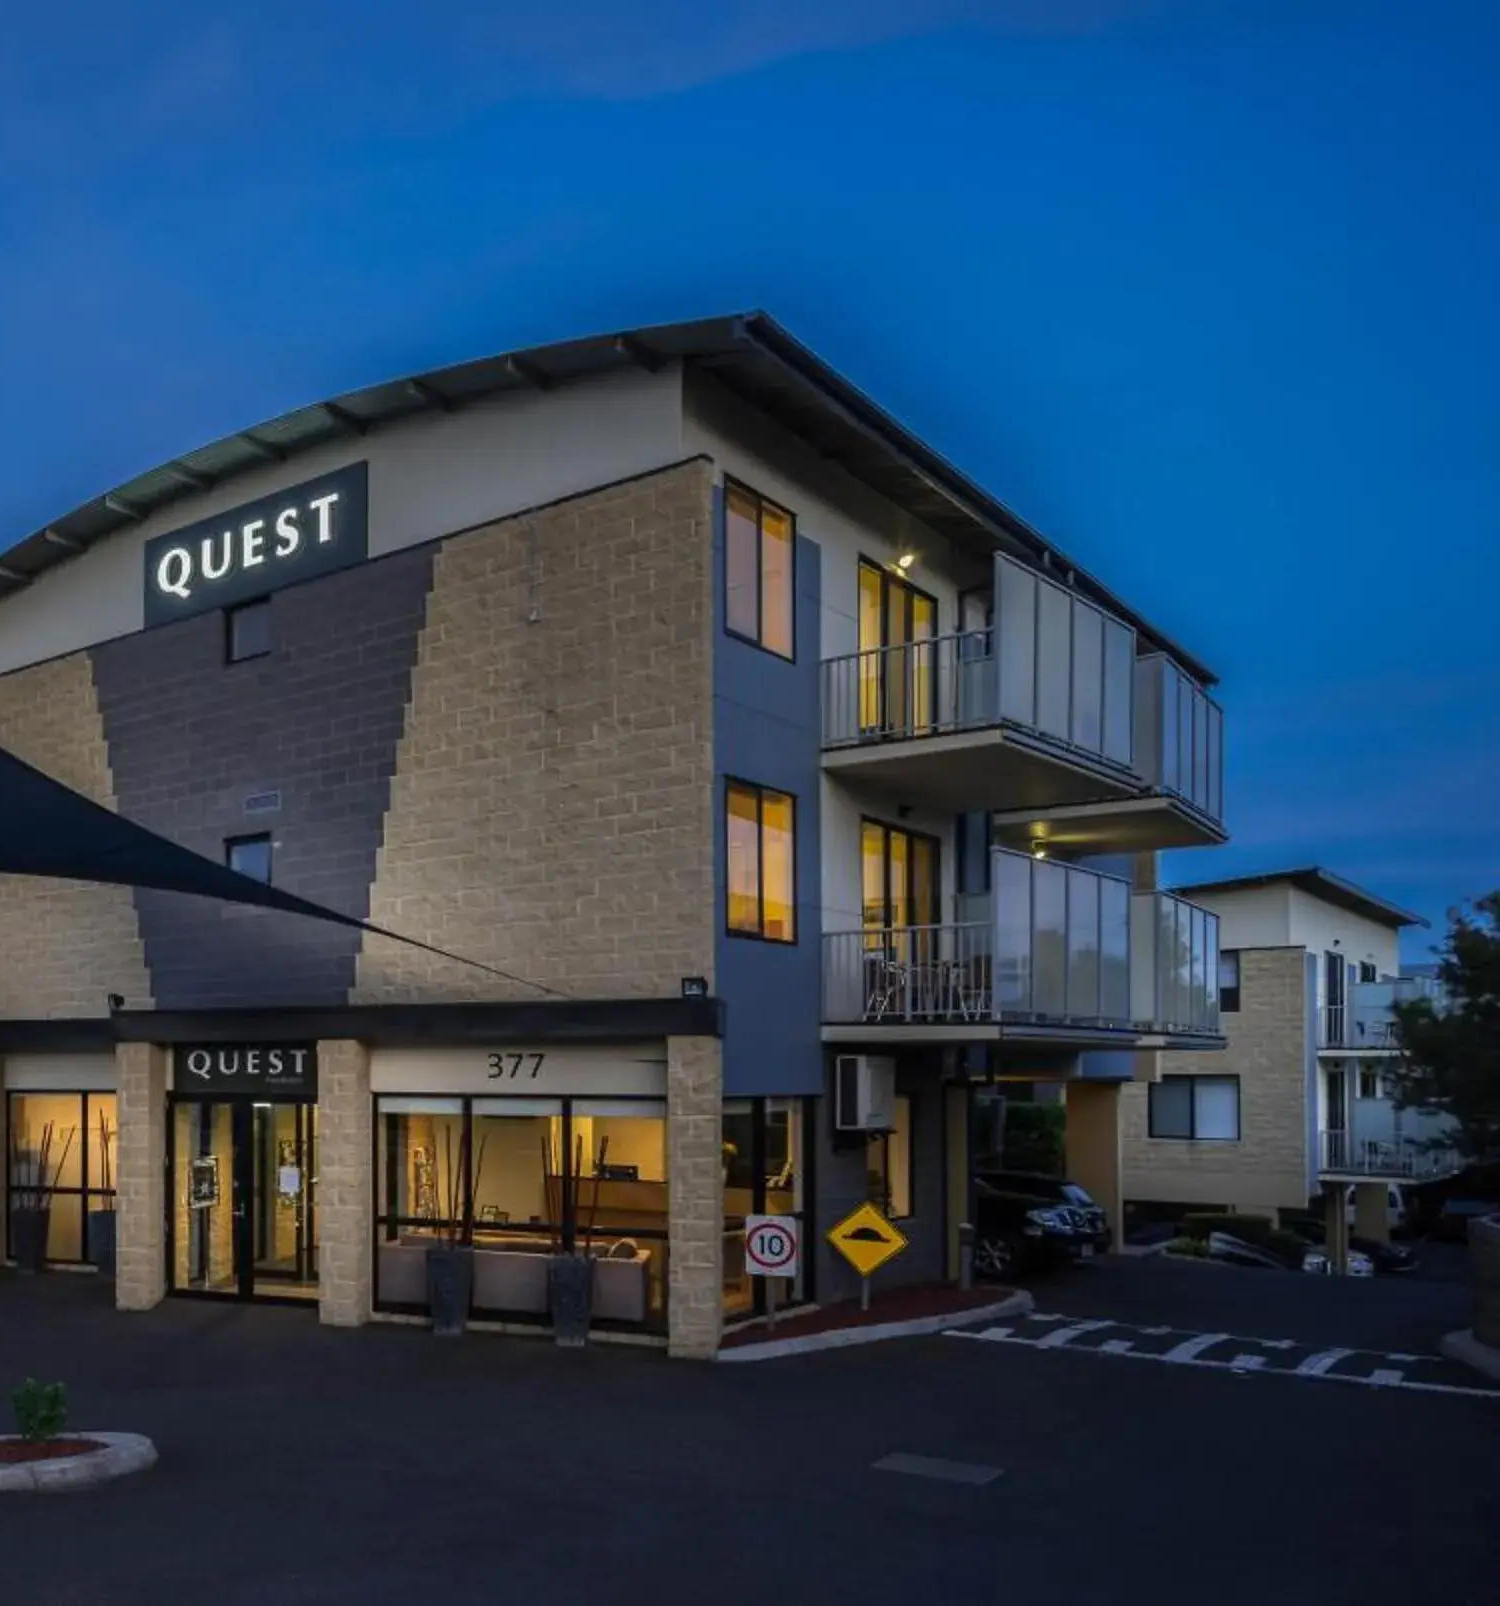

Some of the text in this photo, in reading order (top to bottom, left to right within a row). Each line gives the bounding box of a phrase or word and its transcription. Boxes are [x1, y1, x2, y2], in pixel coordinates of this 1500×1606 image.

[157, 493, 339, 599] QUEST
[187, 1049, 308, 1079] QUEST
[487, 1053, 546, 1079] 377
[760, 1235, 784, 1256] 10
